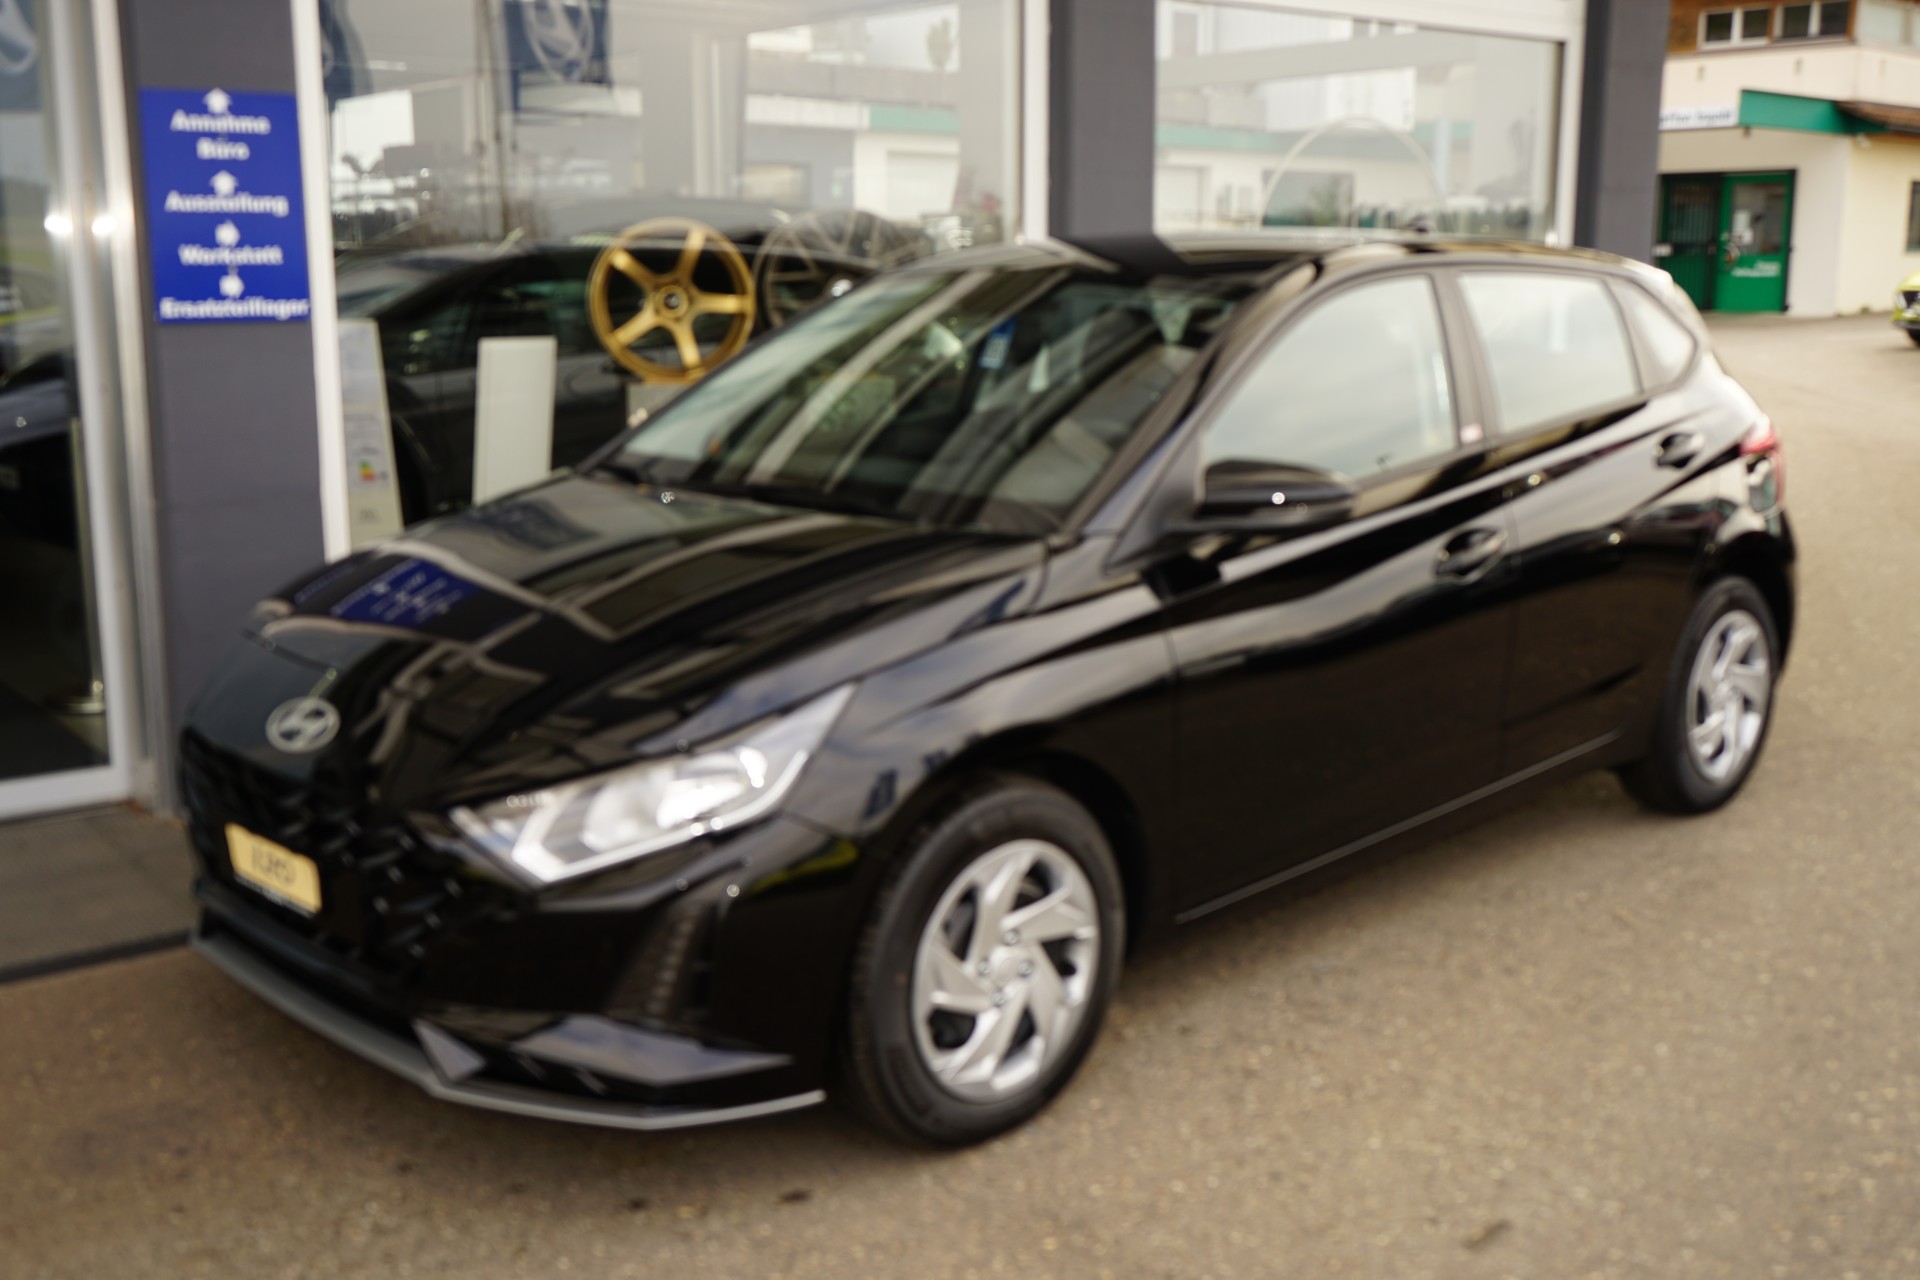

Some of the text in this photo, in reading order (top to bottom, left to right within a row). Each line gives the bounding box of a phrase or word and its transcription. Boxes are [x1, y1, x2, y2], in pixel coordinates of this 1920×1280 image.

[171, 109, 271, 134] Annahme
[197, 138, 249, 160] Büro
[165, 190, 289, 217] Ausstellung
[178, 243, 284, 265] Werkstatt
[160, 296, 309, 320] Ersatzteillager
